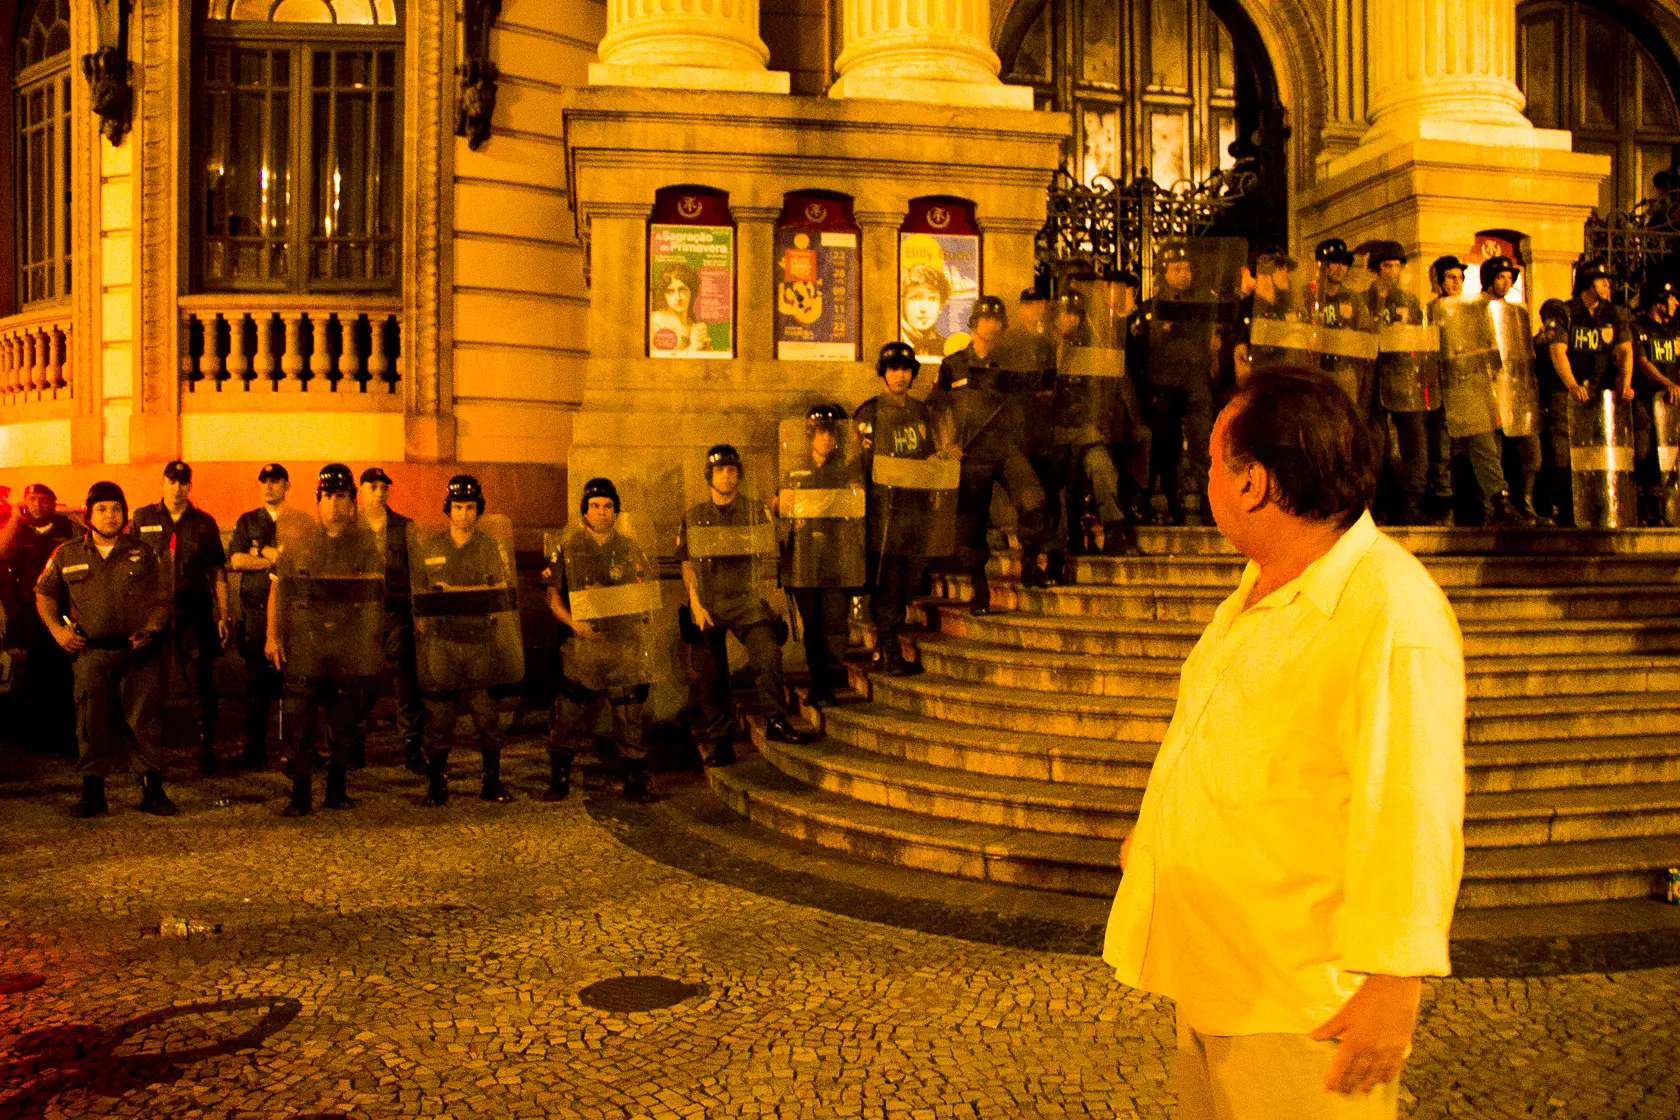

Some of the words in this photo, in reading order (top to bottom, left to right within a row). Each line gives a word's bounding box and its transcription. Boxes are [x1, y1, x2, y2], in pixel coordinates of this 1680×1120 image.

[662, 231, 713, 243] Sagração
[670, 242, 728, 253] Primavera
[906, 247, 934, 261] Billy
[1574, 328, 1599, 350] H-10
[1653, 339, 1673, 361] H-11
